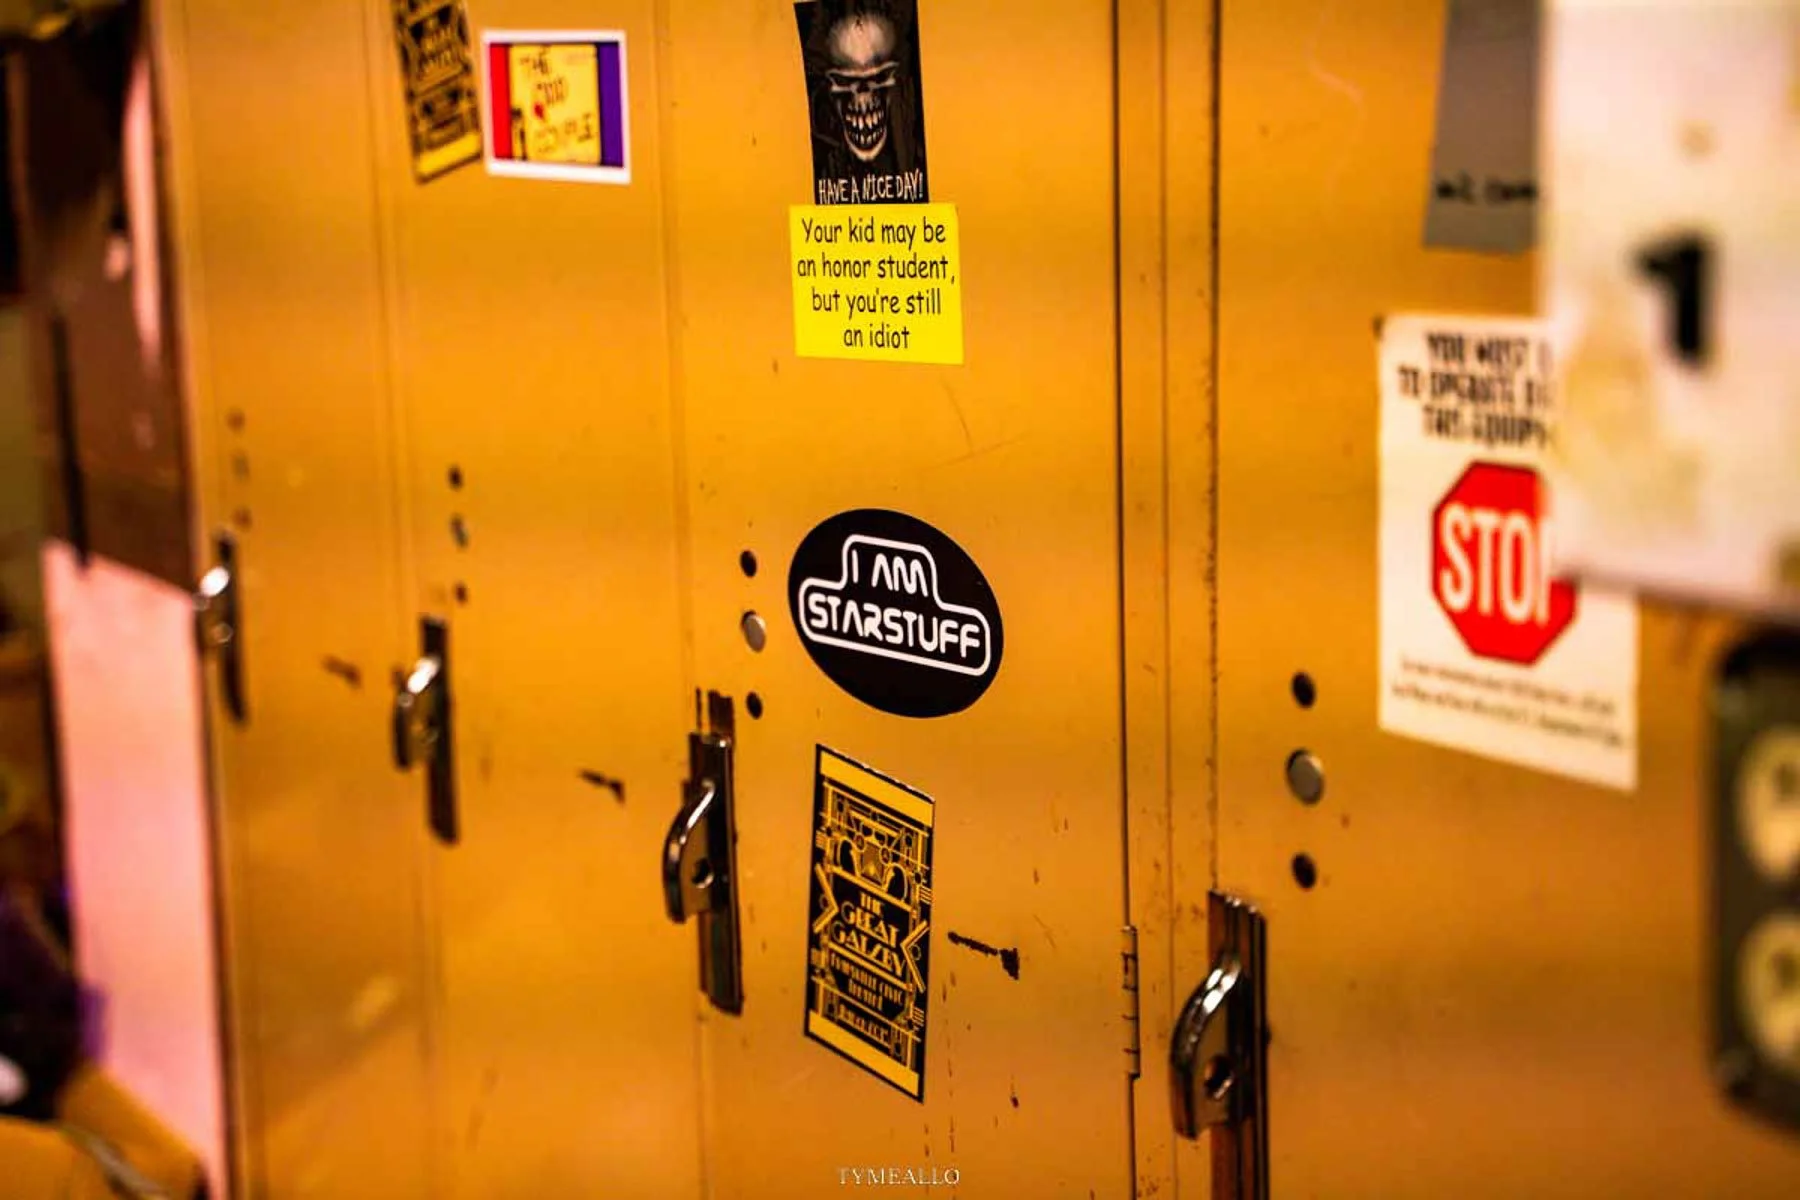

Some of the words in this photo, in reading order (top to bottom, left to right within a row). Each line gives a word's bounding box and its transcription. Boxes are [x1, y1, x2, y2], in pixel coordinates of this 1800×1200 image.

[818, 178, 849, 204] HAVE
[851, 176, 861, 204] A
[862, 173, 895, 201] NICE
[896, 168, 924, 202] DAY!
[802, 217, 842, 244] Your
[849, 216, 875, 244] kid
[881, 223, 916, 251] may
[923, 216, 946, 244] be
[797, 258, 817, 278] an
[821, 252, 871, 279] honor
[877, 252, 955, 285] student,
[811, 286, 840, 312] but
[846, 287, 901, 320] you're
[906, 287, 941, 315] still
[843, 328, 863, 348] an
[869, 323, 910, 349] idiot
[852, 549, 859, 584] I
[871, 552, 929, 598] AM
[808, 593, 981, 659] STARSTUFF
